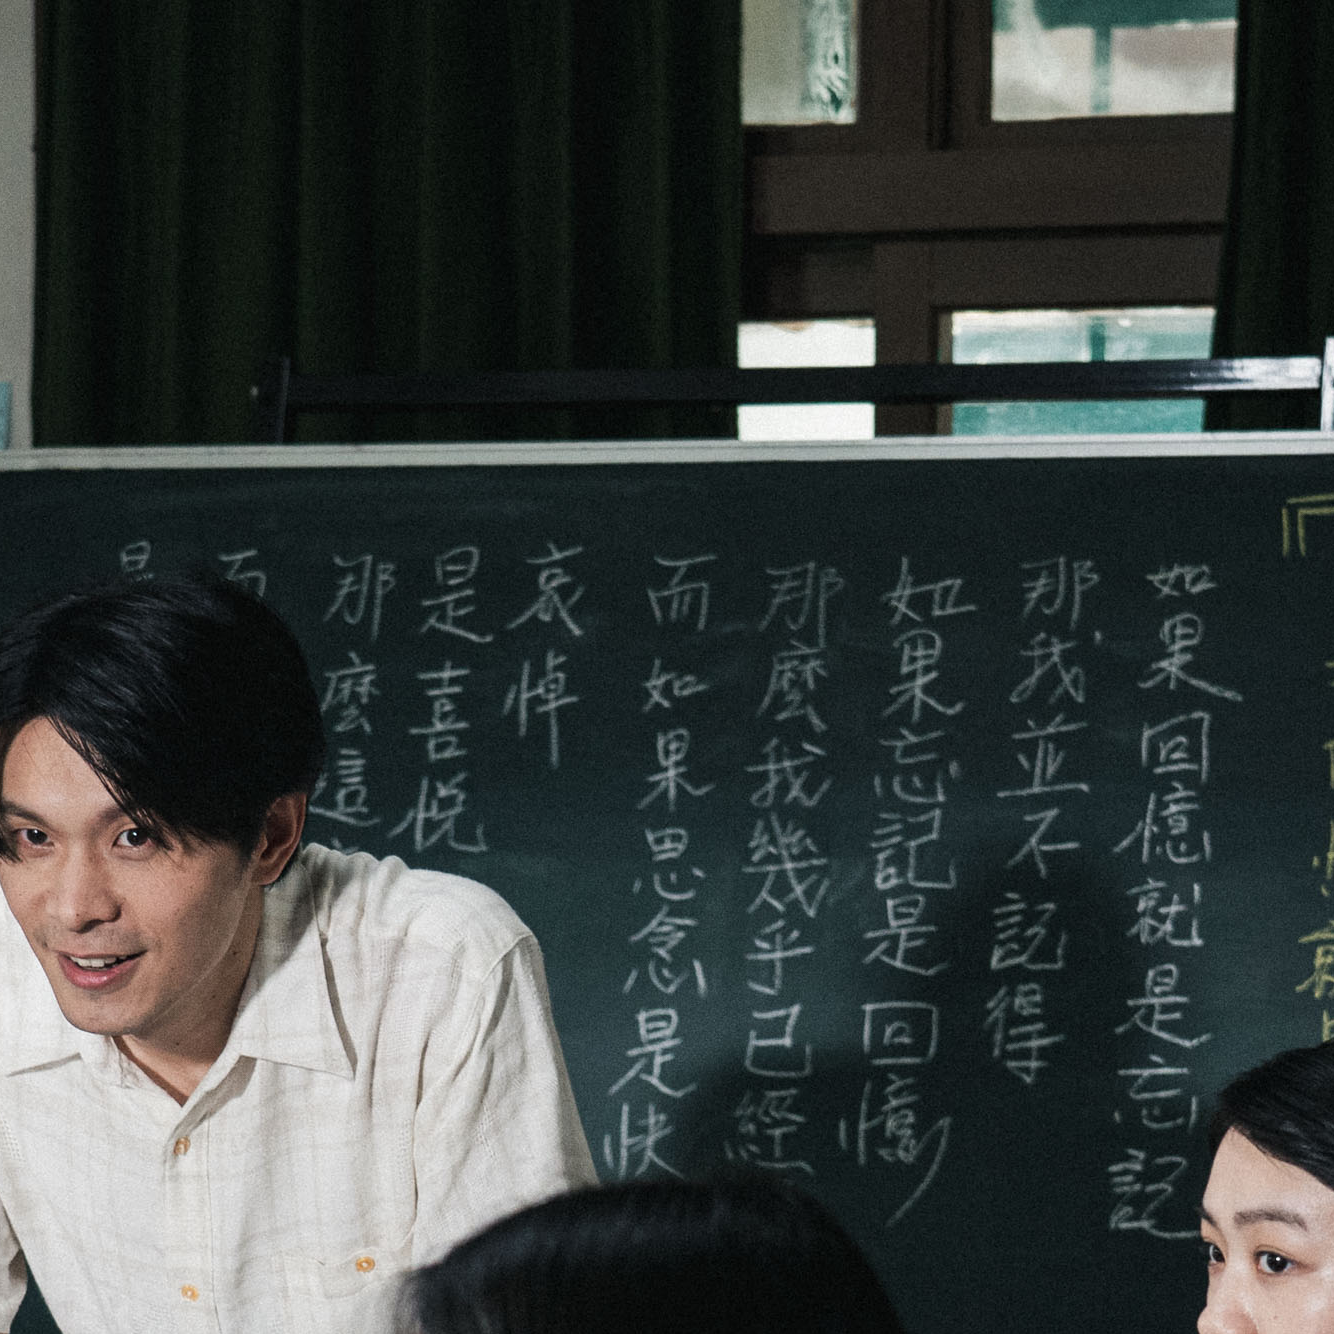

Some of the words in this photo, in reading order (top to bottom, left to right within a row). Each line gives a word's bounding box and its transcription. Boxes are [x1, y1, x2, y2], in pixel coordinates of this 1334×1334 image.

[387, 546, 493, 854] 是喜悅
[503, 543, 585, 769] 哀悼
[604, 554, 720, 1180] 而如果思念是快
[723, 560, 845, 1176] 那麼我幾乎已經
[839, 556, 977, 1228] 如果忘記是回憶
[985, 556, 1099, 1084] 那我並不記得
[1107, 562, 1244, 1240] 如果回憶就是忘記
